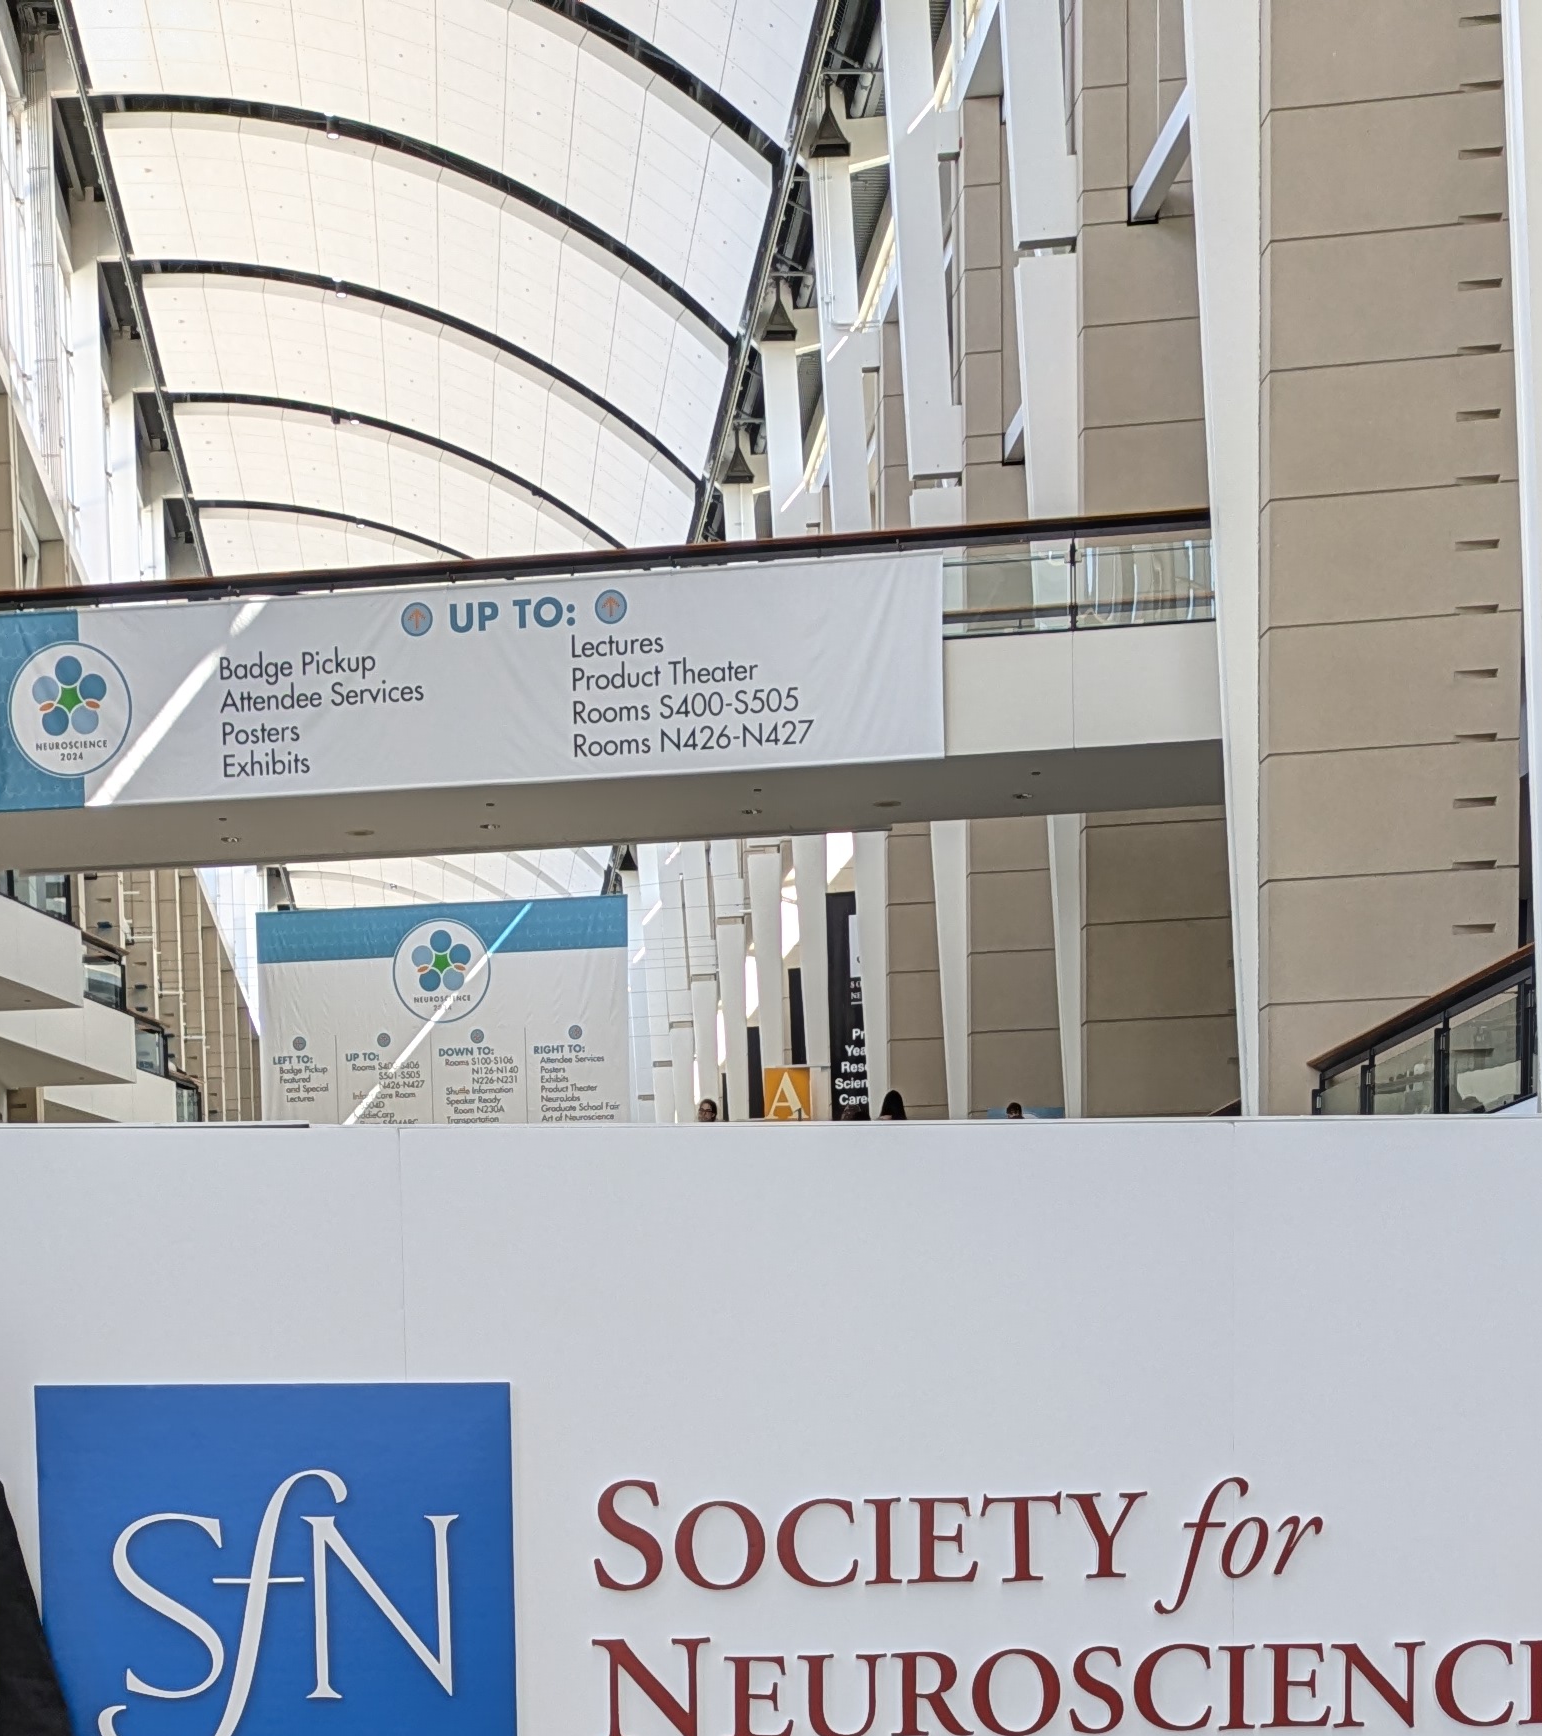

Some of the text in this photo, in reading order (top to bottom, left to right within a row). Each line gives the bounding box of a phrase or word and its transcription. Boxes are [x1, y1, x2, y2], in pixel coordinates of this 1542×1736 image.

[449, 596, 576, 633] UP TO:
[570, 634, 664, 658] Lectures
[219, 647, 376, 685] Badge Pickup
[571, 656, 759, 692] Product Theater
[220, 679, 425, 714] Attendee Services
[572, 686, 800, 725] Rooms S400-S505
[221, 721, 301, 747] Posters
[573, 719, 815, 758] Rooms N426-N427
[35, 738, 109, 752] NEUROSCIENCE
[60, 751, 84, 762] 2024
[222, 752, 311, 779] Exhibits
[439, 1046, 495, 1057] DOWN TO:
[533, 1043, 586, 1055] RIGHT TO:
[273, 1055, 314, 1066] LEFT TO:
[345, 1052, 380, 1062] UP TO:
[445, 1058, 469, 1067] Rooms
[540, 1054, 605, 1064] Attendee Services
[279, 1065, 328, 1075] Badge Pickup
[540, 1065, 566, 1074] Posters
[279, 1076, 311, 1085] Featured
[540, 1074, 569, 1084] Exhibits
[835, 1077, 869, 1090] Scien
[286, 1083, 329, 1093] and Special
[471, 1086, 514, 1095] Information
[541, 1083, 598, 1094] Product Theater
[765, 1072, 810, 1120] A
[579, 1102, 603, 1111] School
[593, 1476, 1323, 1615] SOCIETY for
